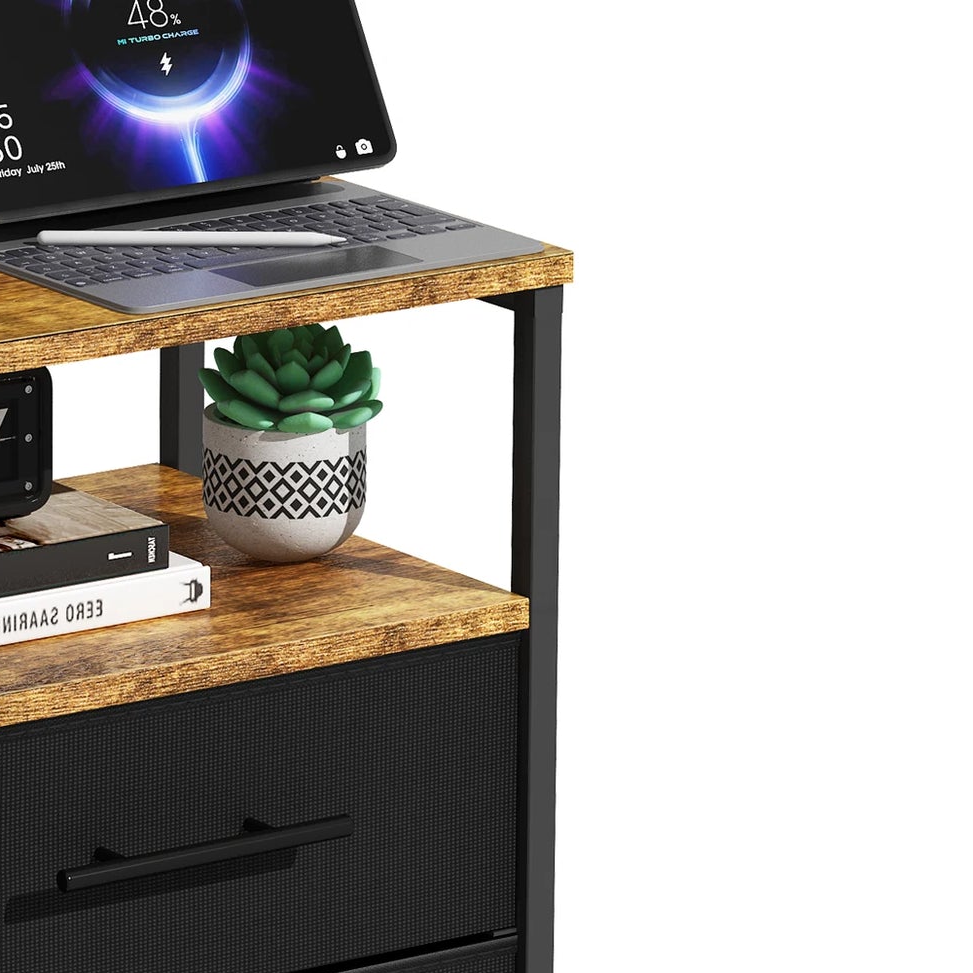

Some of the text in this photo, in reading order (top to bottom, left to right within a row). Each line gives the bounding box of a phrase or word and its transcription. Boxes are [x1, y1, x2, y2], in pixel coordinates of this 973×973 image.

[128, 34, 161, 44] TURBO
[162, 28, 200, 39] CHARGE
[26, 164, 44, 174] July
[45, 160, 66, 172] 25th
